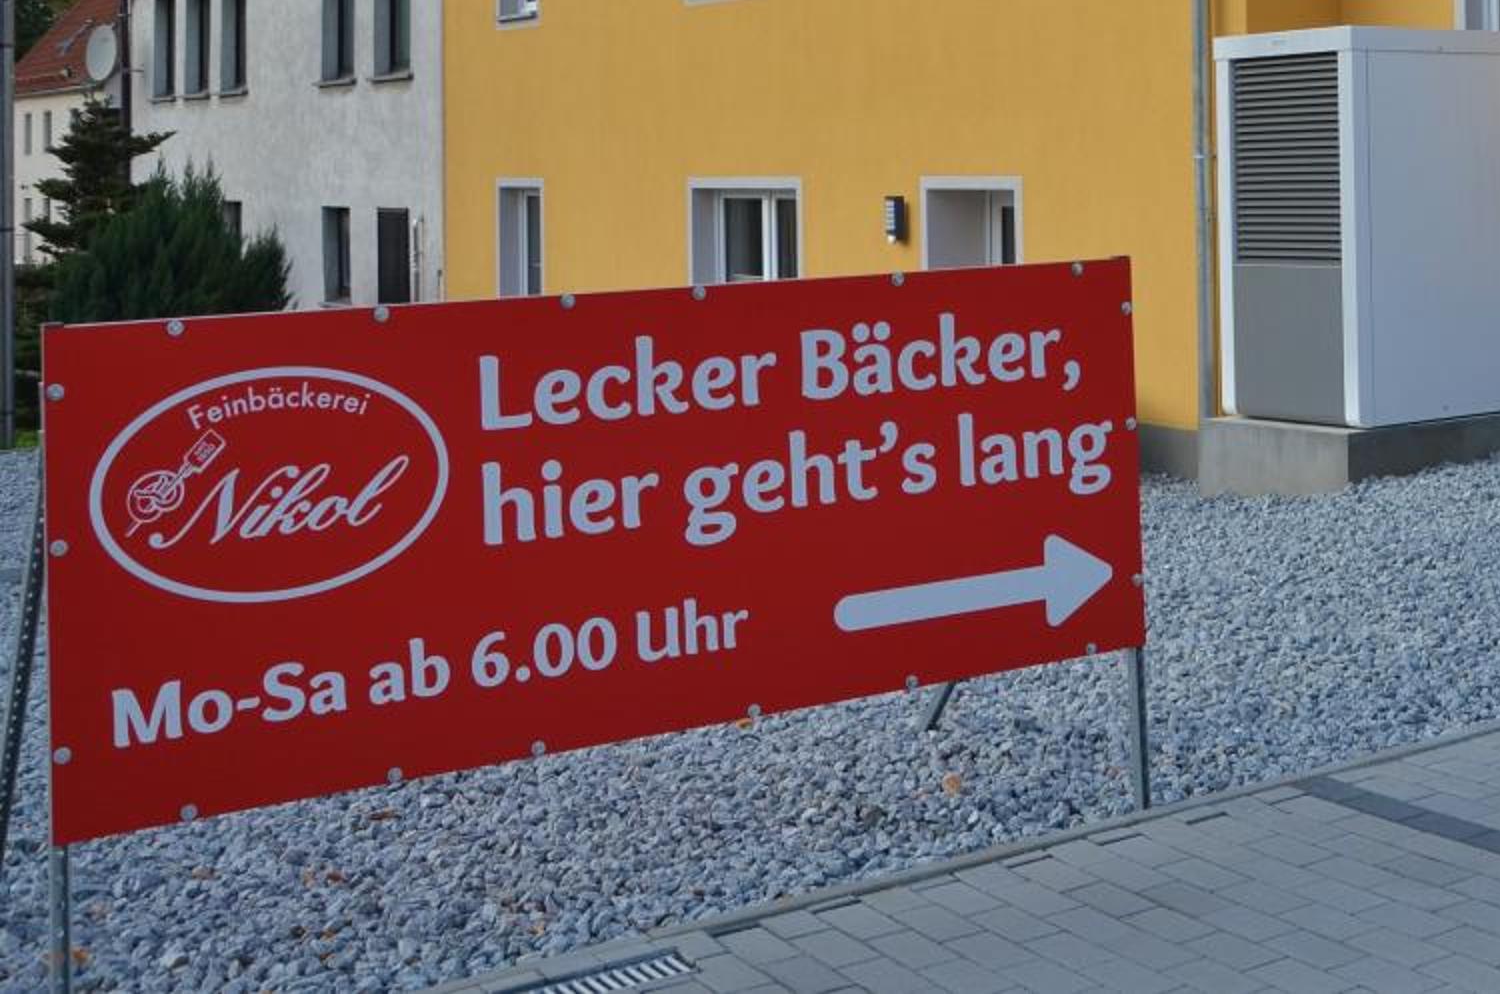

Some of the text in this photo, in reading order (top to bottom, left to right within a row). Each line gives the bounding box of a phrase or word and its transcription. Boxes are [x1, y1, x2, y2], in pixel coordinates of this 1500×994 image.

[187, 382, 372, 431] Feinbäckerei
[479, 312, 1082, 431] Lecker Bäcker,
[148, 455, 410, 549] Nikol
[481, 412, 1113, 547] hier geht’s lang
[111, 597, 750, 748] Mo-Sa ab 6.00 Uhr
